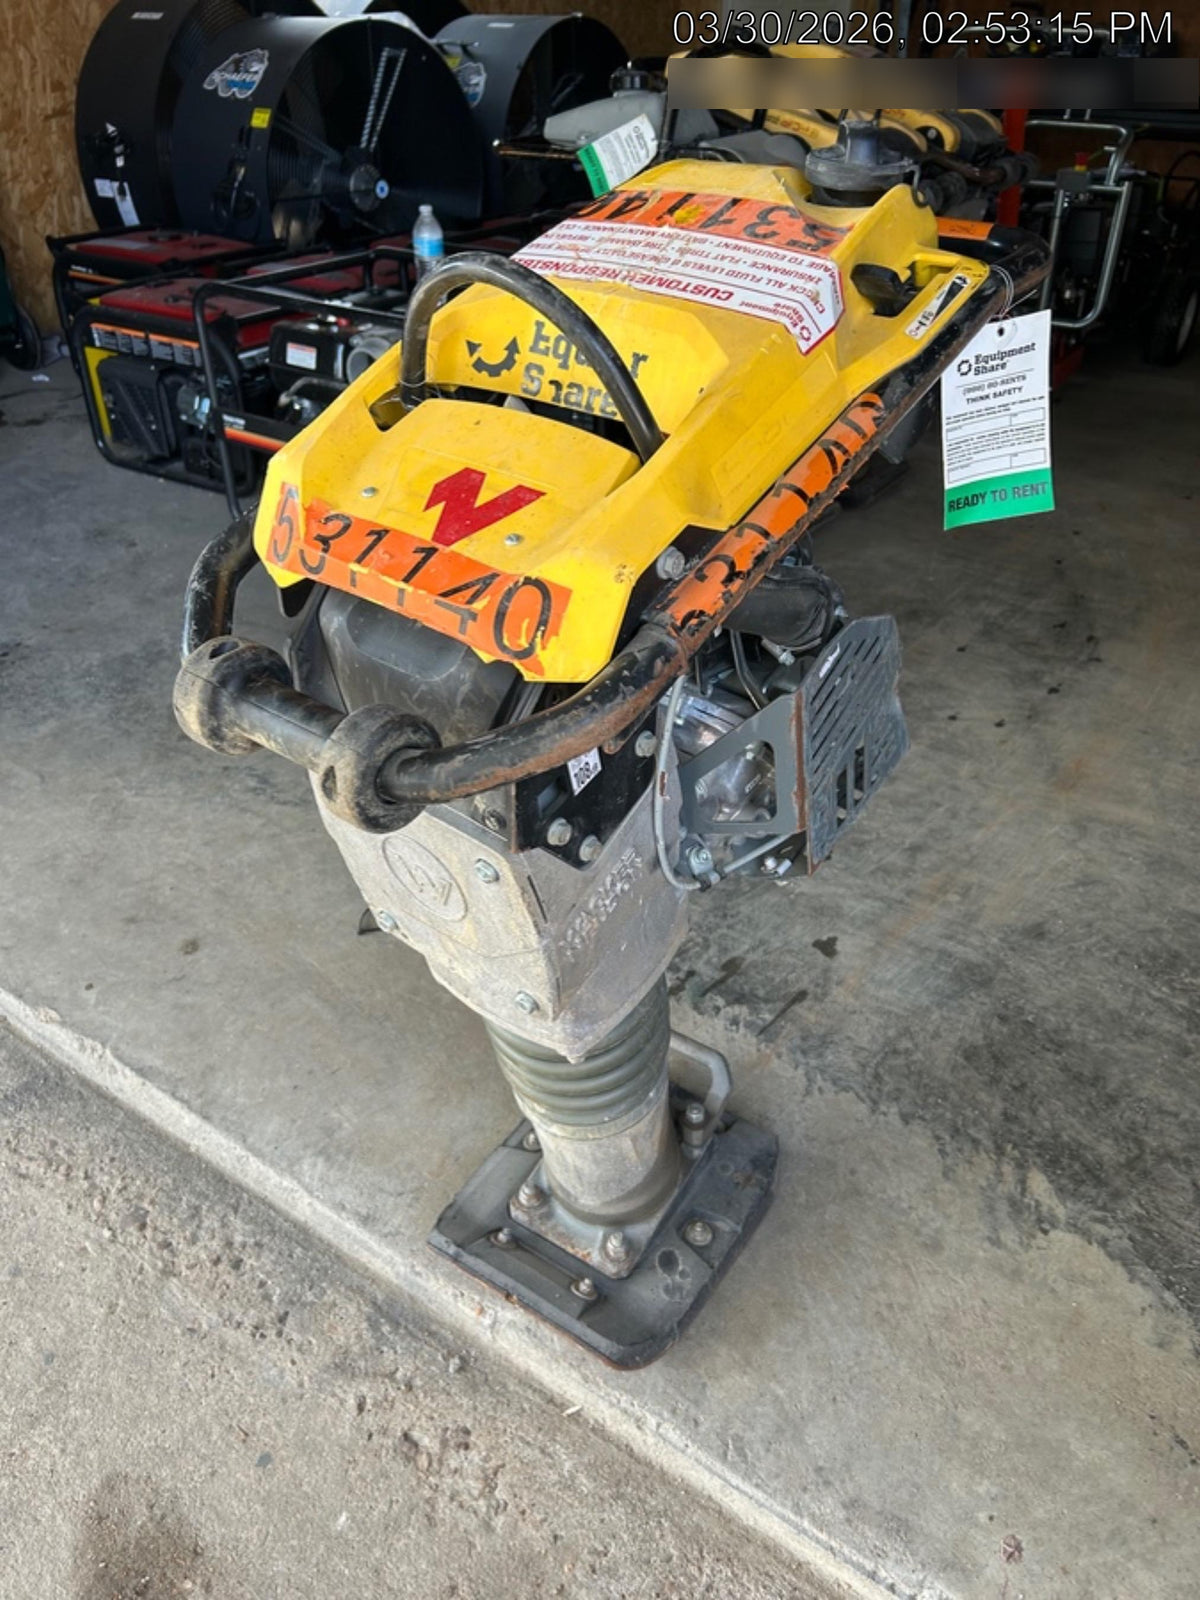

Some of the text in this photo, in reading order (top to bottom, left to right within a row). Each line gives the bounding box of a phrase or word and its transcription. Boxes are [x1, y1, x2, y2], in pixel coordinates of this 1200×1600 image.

[710, 252, 742, 265] FLAT
[713, 240, 788, 261] EQUIPMENT
[788, 255, 805, 267] TO
[724, 268, 764, 284] FLUID
[747, 260, 822, 286] INSURANCE
[765, 278, 788, 291] ALL
[973, 342, 1037, 366] Equipment
[973, 361, 1008, 377] Share
[966, 385, 1024, 405] THINK SAFETY
[947, 480, 1049, 514] READY TO RENT
[272, 484, 553, 661] 531140
